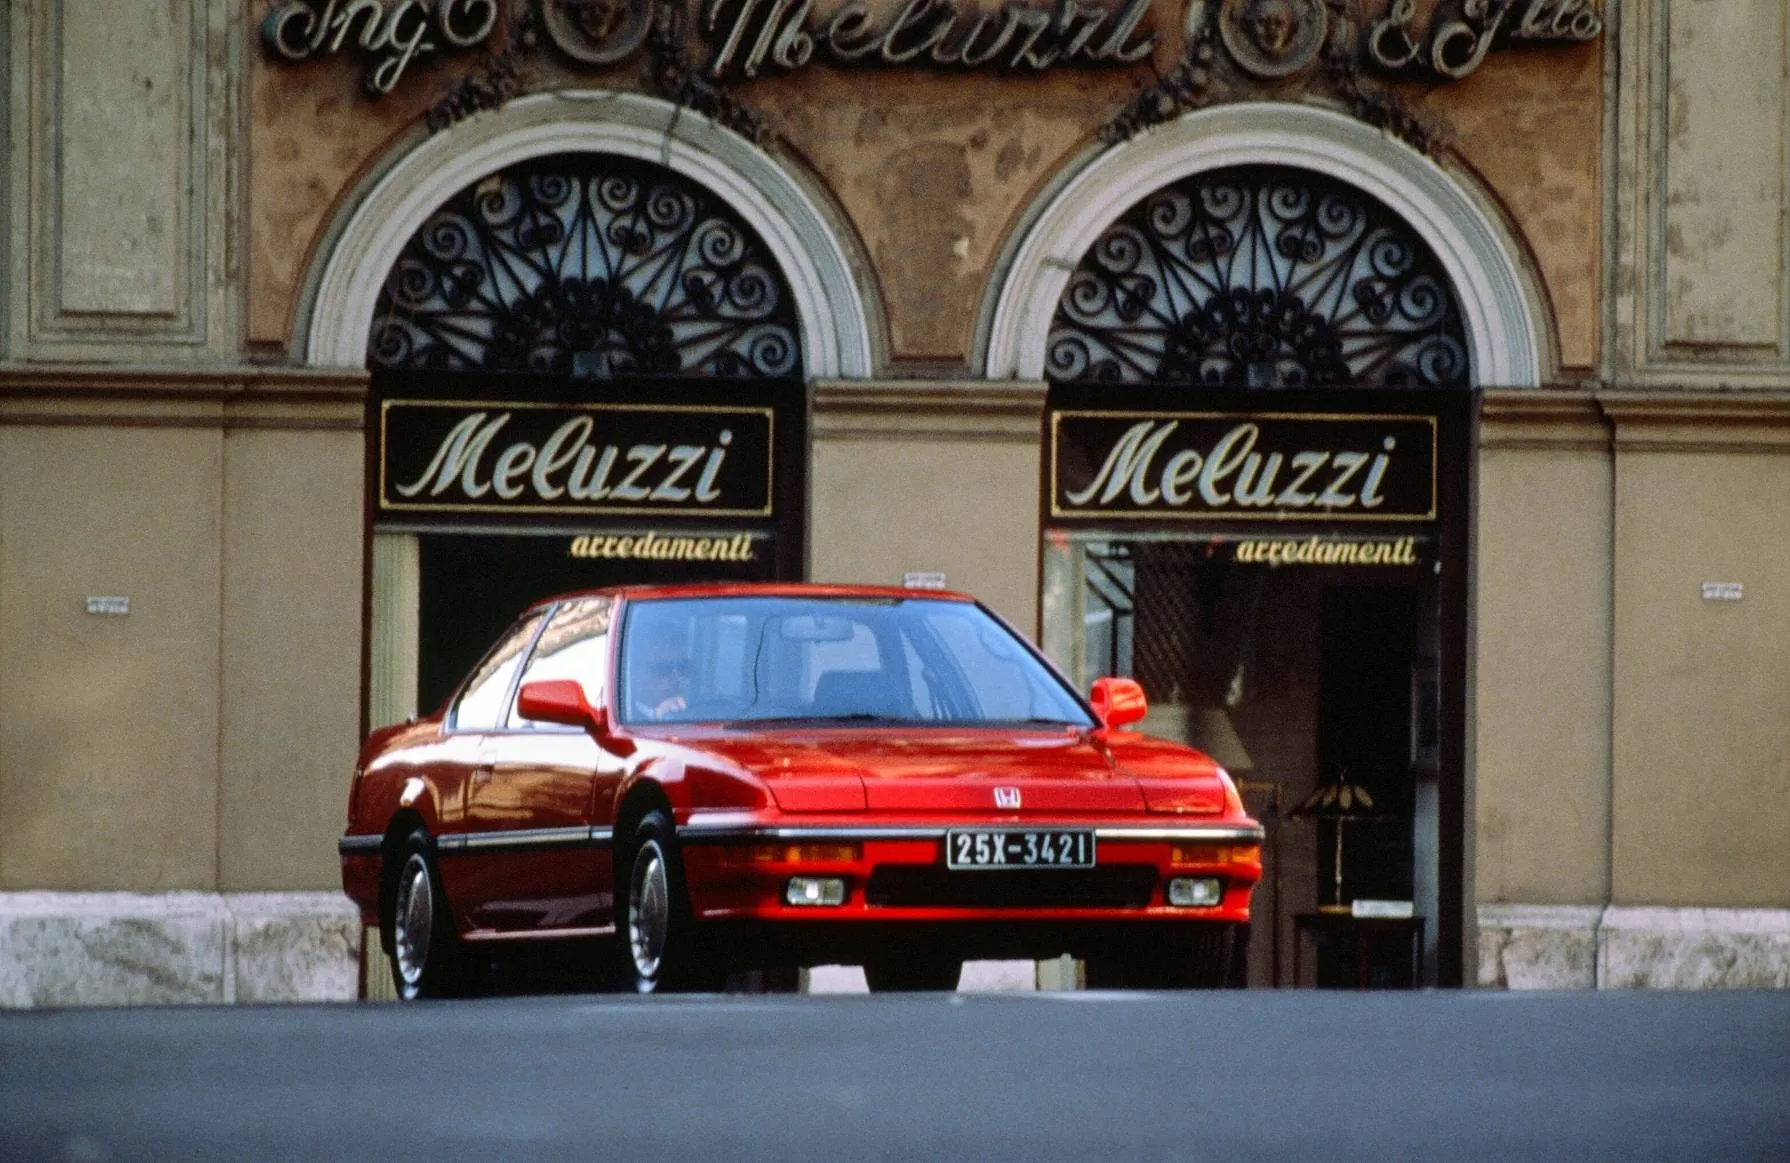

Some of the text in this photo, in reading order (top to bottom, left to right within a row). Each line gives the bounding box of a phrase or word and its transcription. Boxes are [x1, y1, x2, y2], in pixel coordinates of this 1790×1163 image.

[396, 411, 733, 502] Meluzzi
[1065, 419, 1396, 508] Meluzzi
[570, 531, 754, 561] arredamenti
[1235, 535, 1416, 564] arredamenti
[957, 833, 1086, 864] 25X-3421
